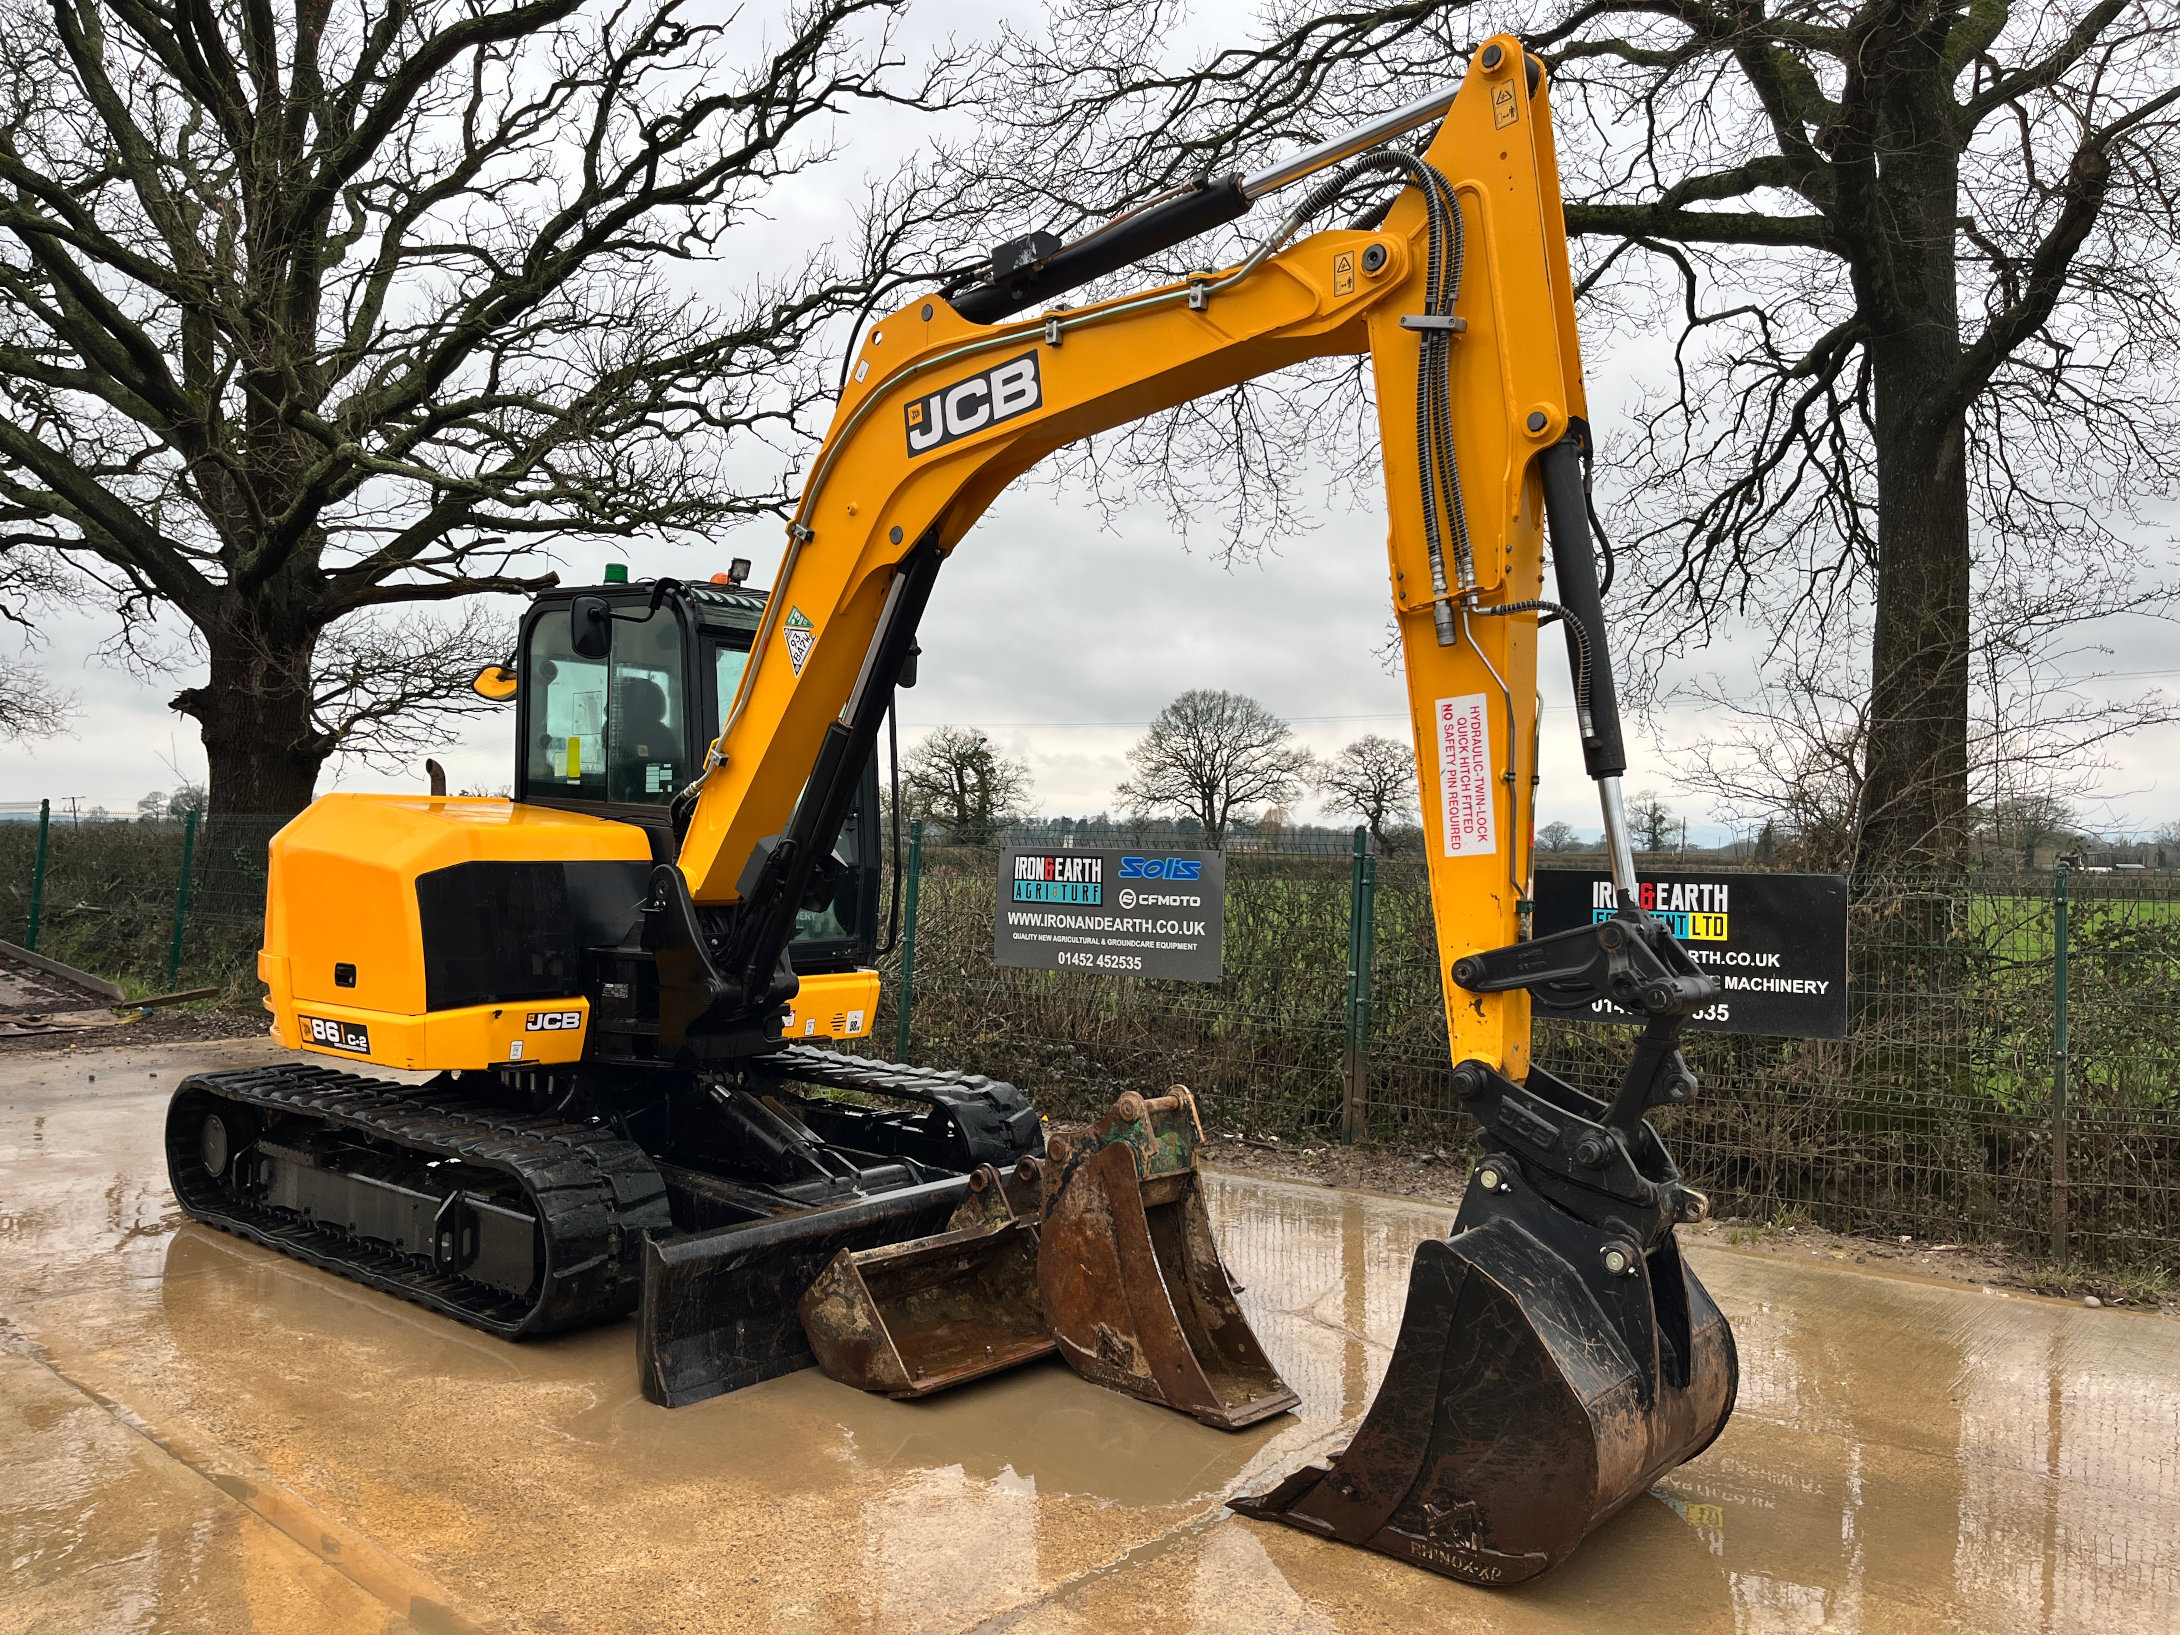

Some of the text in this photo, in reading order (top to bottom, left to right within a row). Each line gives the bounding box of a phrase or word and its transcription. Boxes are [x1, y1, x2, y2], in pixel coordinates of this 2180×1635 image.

[909, 358, 1038, 450] JCB
[1442, 703, 1462, 850] NO SAFETY PIN REQUIRED
[1457, 717, 1474, 834] QUICK HITCH FITTED
[1469, 705, 1488, 842] HYDRAULIC-TWIN-LOCK
[1016, 883, 1099, 902] AGRI TURF
[1138, 894, 1201, 907] CFMOTO
[1008, 911, 1206, 936] WWW.IRONANDEARTH.CO.UK
[1692, 915, 1724, 937] LTD
[1012, 932, 1038, 941] QUALITY
[1038, 934, 1052, 942] NEW
[1052, 935, 1100, 945] AGRICULTURAL
[1107, 938, 1155, 949] GROUNDCARE
[1156, 941, 1198, 951] EQUIPMENT
[1058, 951, 1142, 971] 01452 452535
[1724, 976, 1829, 995] MACHINERY
[311, 1018, 340, 1043] 86
[527, 1011, 581, 1031] JCB
